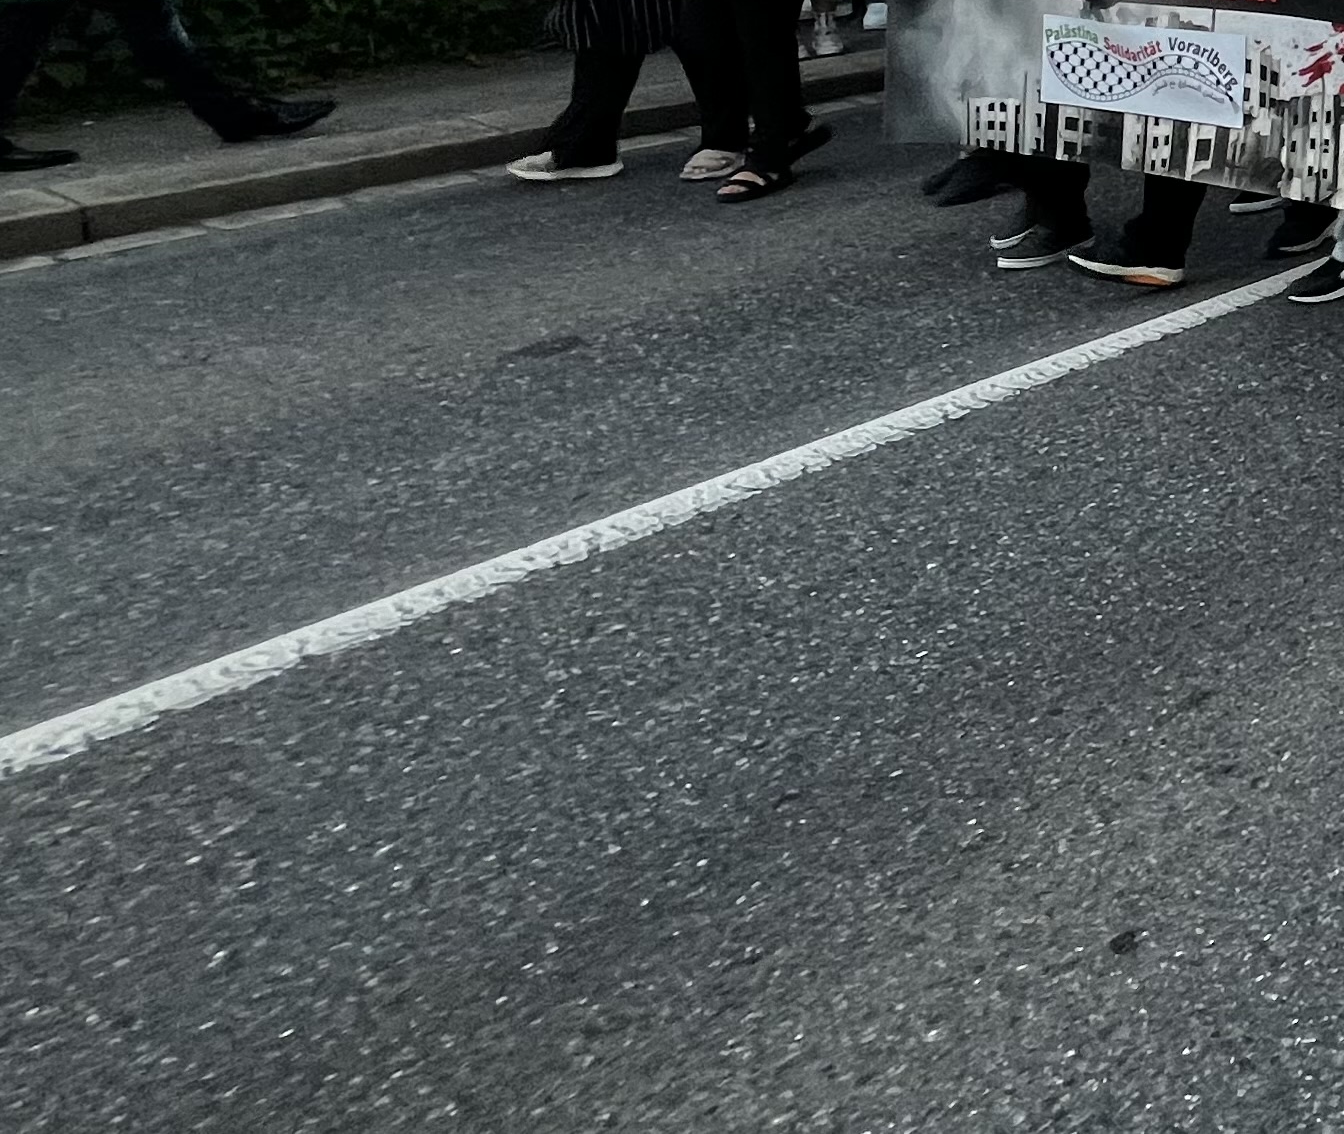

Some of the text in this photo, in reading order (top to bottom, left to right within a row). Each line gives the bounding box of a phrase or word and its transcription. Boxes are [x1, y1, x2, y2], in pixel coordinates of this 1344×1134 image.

[1044, 25, 1099, 45] Palästina
[1103, 36, 1163, 63] Solidarität
[1167, 36, 1240, 92] Vorarlberg
